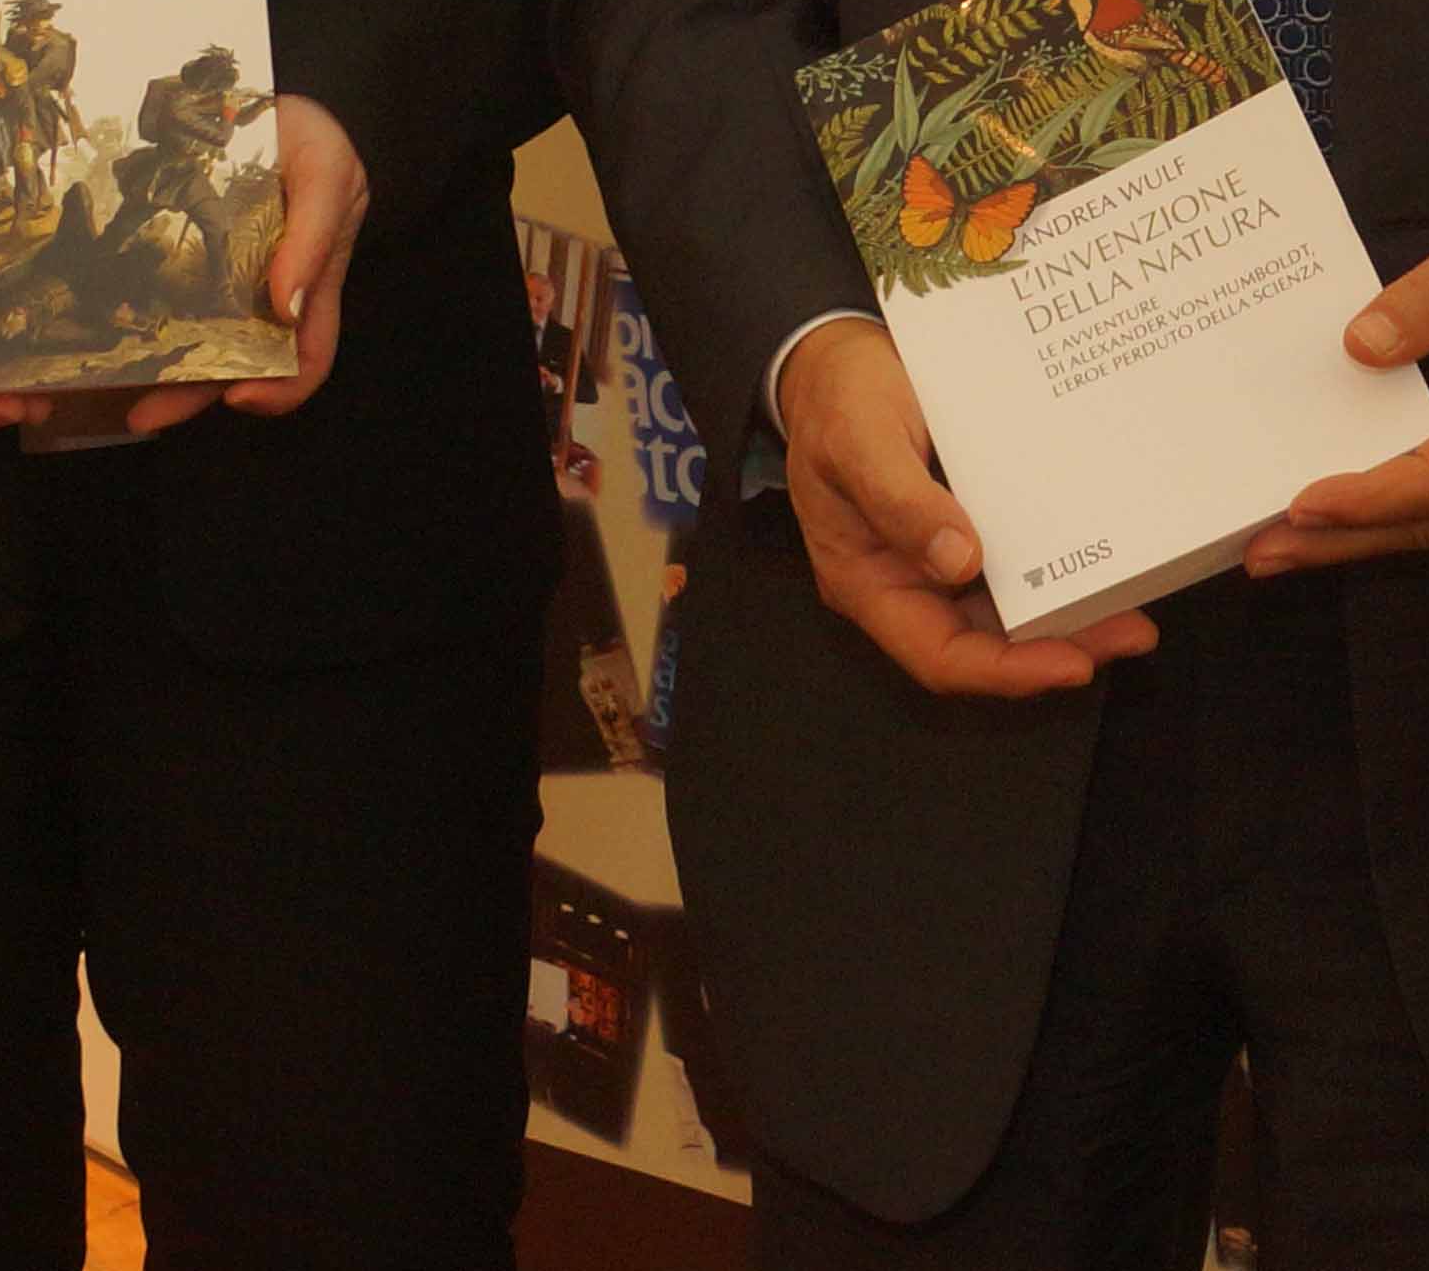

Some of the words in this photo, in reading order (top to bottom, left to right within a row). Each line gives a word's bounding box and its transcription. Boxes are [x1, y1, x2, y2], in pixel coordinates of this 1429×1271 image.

[1010, 168, 1248, 302] L'INVENZIONE
[1019, 194, 1118, 253] ANDREA
[1117, 155, 1187, 203] WULF
[1023, 270, 1134, 335] DELLA
[1137, 197, 1281, 283] NATURA
[1037, 342, 1059, 362] LE
[1061, 296, 1161, 352] AVVENTURE
[1044, 362, 1066, 380] DI
[1068, 315, 1169, 370] ALEXANDER
[1168, 295, 1210, 322] VON
[1212, 243, 1316, 302] HUMBOLDT,
[1052, 363, 1111, 398] L'EROE
[1112, 324, 1194, 371] PERDUTO
[1197, 298, 1251, 332] DELLA
[1253, 261, 1325, 305] SCIENZA
[1046, 538, 1114, 581] LUISS
